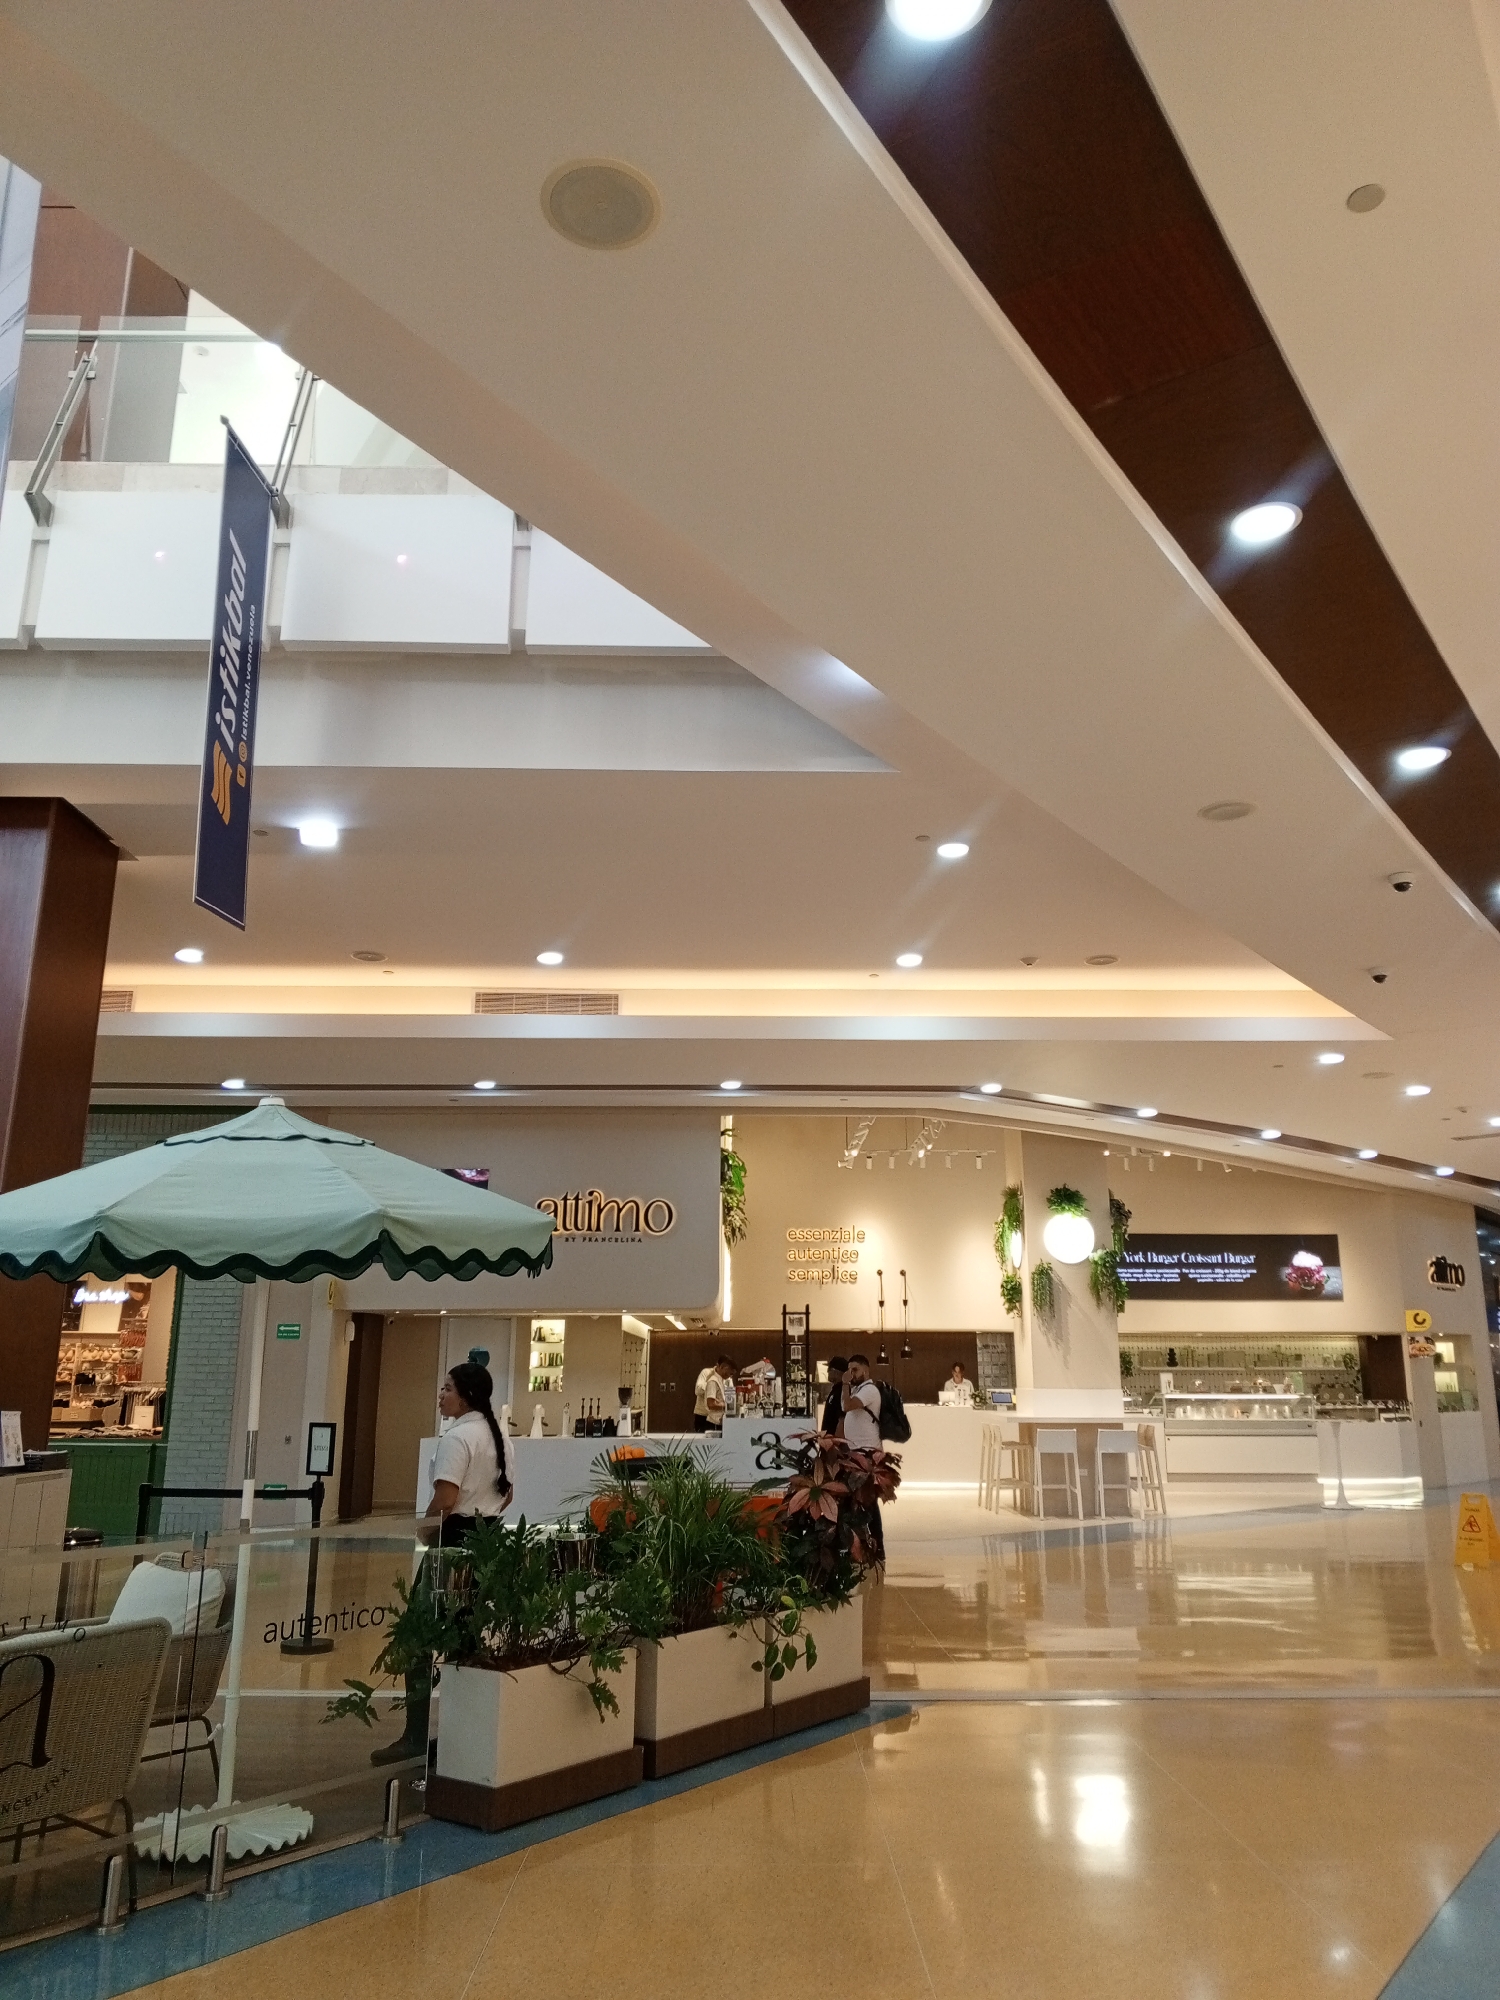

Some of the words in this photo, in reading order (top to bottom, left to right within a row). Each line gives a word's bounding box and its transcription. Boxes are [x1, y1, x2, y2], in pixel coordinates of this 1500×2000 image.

[216, 528, 247, 753] istikbal
[241, 604, 256, 741] istikbal.venezuela
[536, 1189, 674, 1233] attimo
[787, 1224, 866, 1243] essenziale
[788, 1247, 859, 1262] autentico
[1123, 1252, 1146, 1264] York
[1147, 1252, 1180, 1265] Burger
[1181, 1252, 1222, 1264] Croissant
[1223, 1252, 1257, 1265] Burger
[788, 1265, 858, 1285] semplice
[0, 1614, 87, 1642] TTIMO
[263, 1601, 385, 1644] autentico
[1, 1768, 70, 1815] NCELINA
